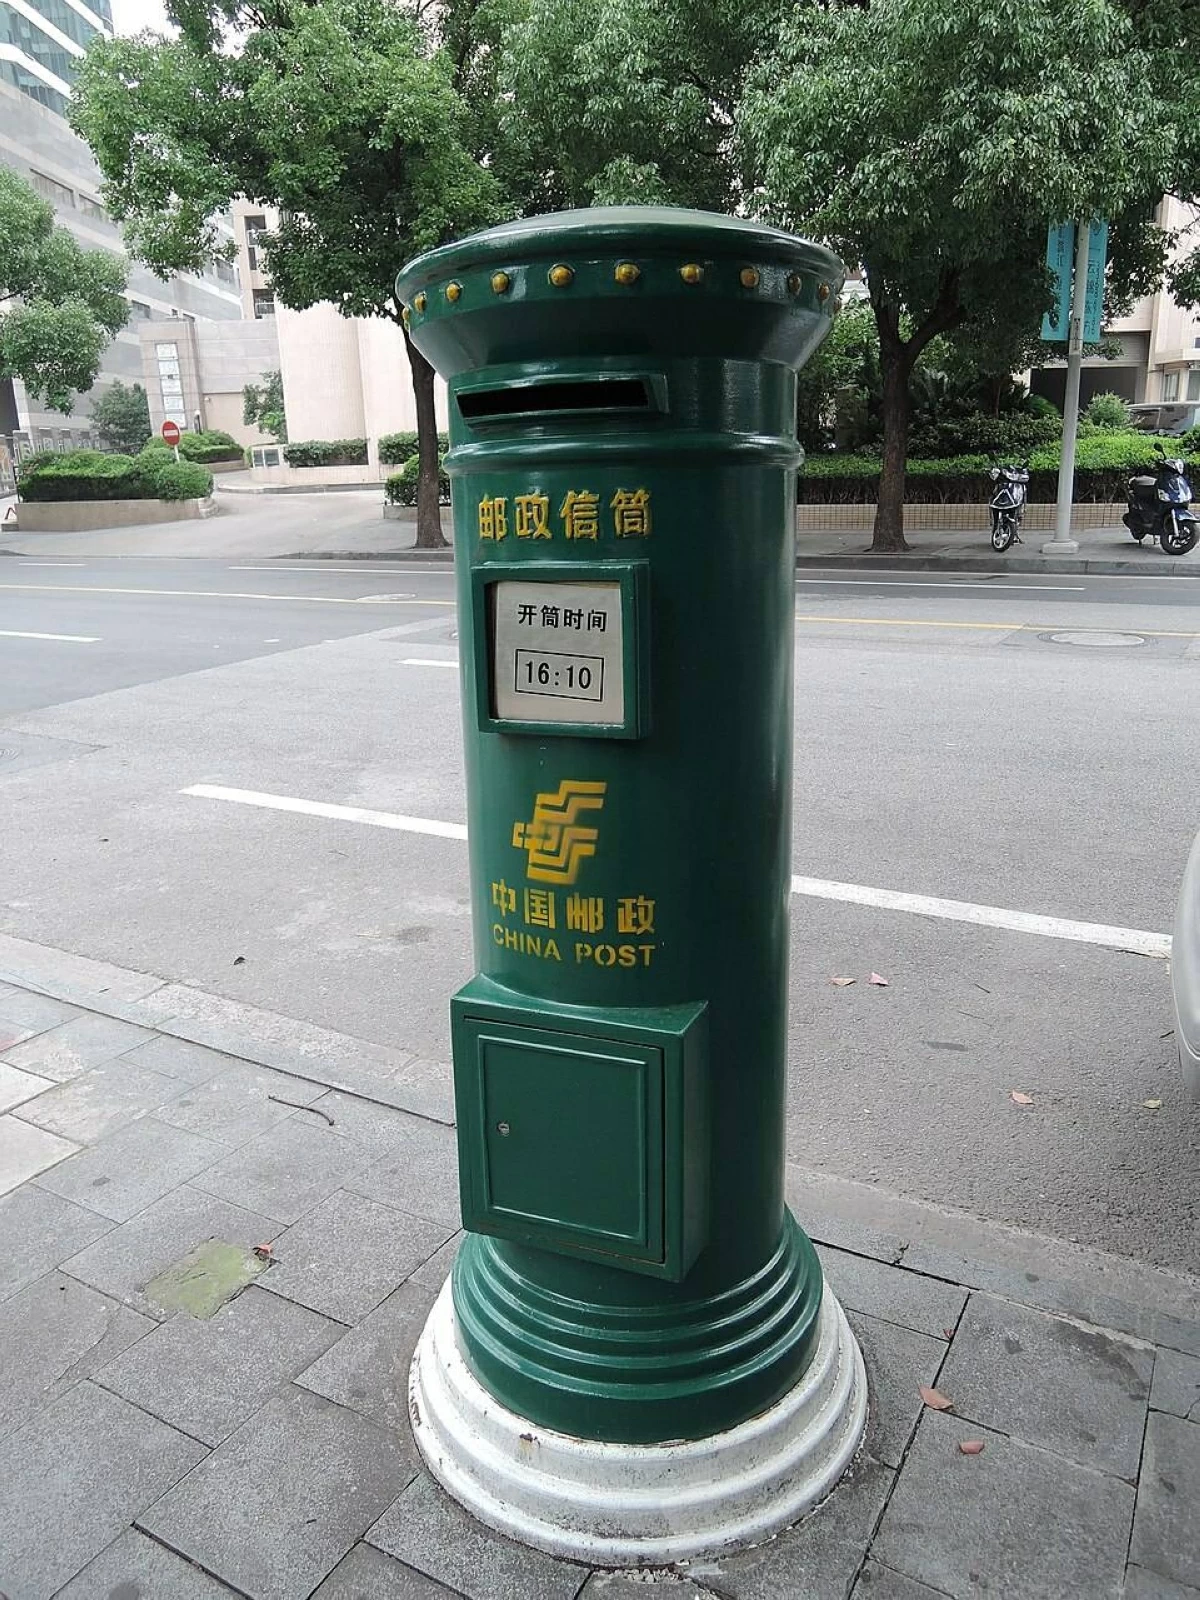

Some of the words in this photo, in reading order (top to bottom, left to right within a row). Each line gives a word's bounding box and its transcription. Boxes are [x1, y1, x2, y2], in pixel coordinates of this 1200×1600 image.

[478, 488, 650, 541] 邮政信筒
[518, 604, 608, 632] 开筒时间
[525, 661, 592, 690] 16:10
[492, 878, 656, 935] 中国邮政
[493, 924, 562, 961] CHINA
[575, 943, 656, 967] POST
